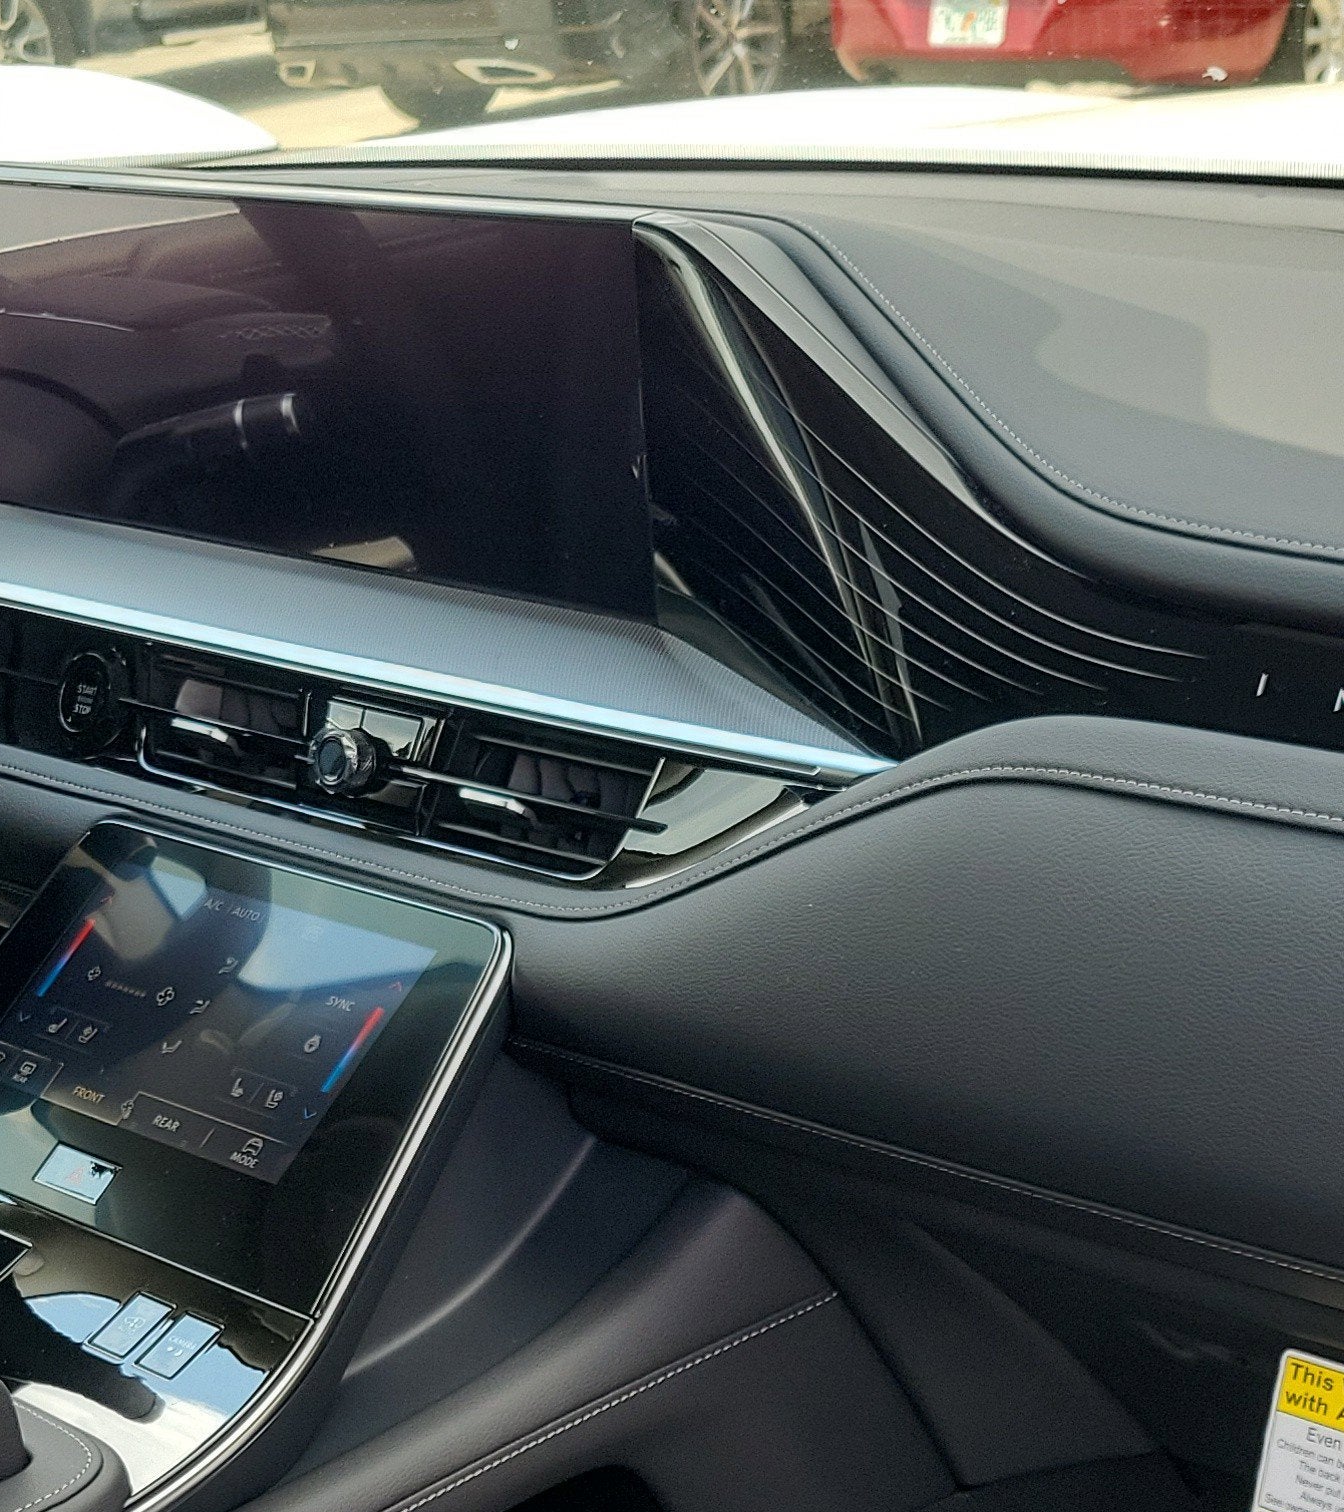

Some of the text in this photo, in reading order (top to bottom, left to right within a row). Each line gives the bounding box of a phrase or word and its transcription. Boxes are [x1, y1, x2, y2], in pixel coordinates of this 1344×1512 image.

[232, 905, 260, 922] AUTO
[326, 995, 356, 1012] SYNC
[73, 1085, 106, 1104] FRONT
[152, 1114, 181, 1133] REAR
[230, 1151, 260, 1170] MODE
[1290, 1362, 1334, 1392] This
[1284, 1391, 1329, 1416] with
[1306, 1427, 1342, 1451] Even
